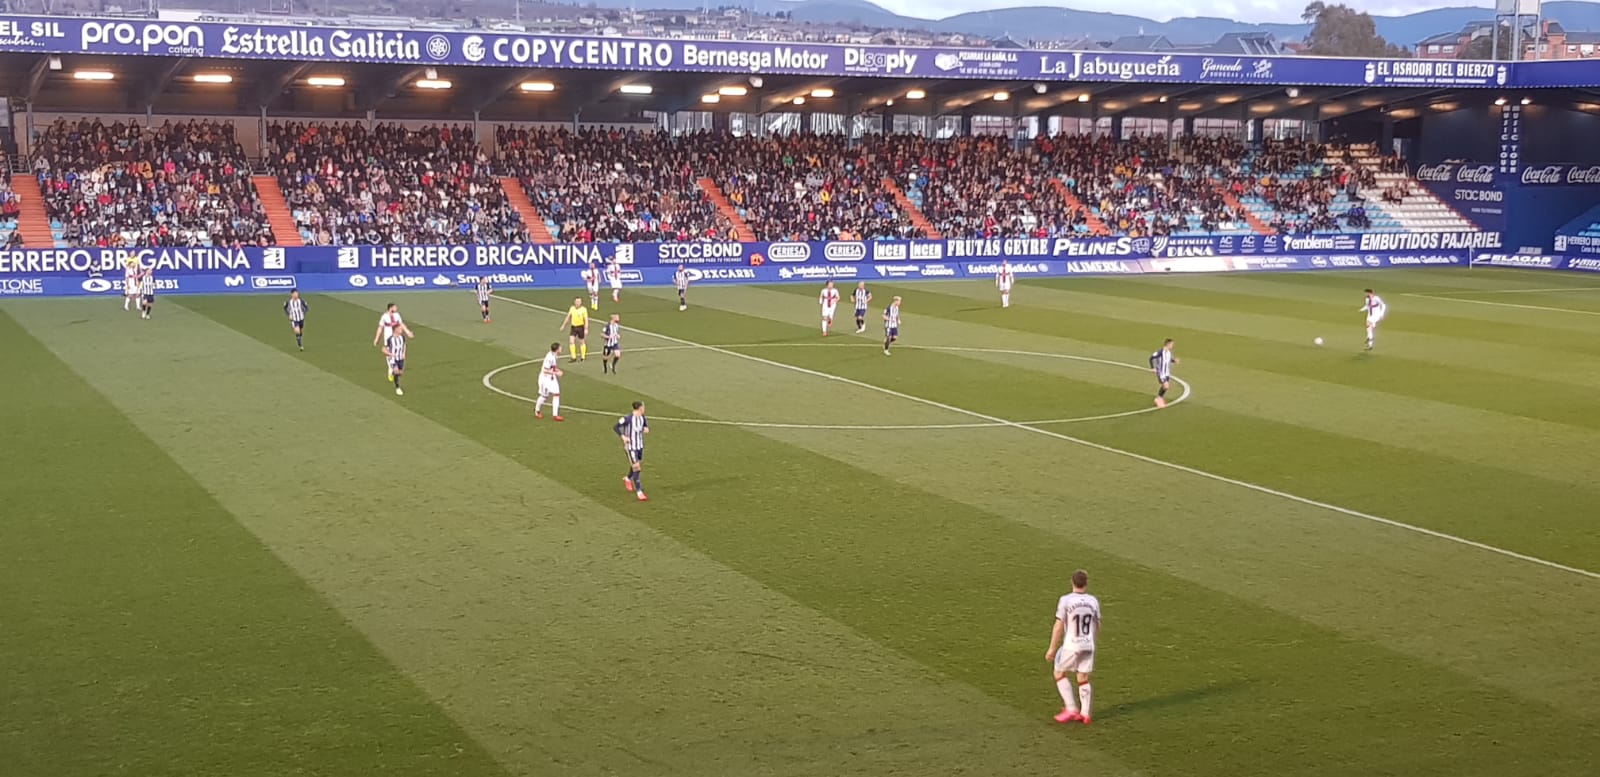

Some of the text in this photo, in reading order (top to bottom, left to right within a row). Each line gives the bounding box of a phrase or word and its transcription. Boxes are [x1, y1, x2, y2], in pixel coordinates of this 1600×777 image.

[31, 22, 64, 37] SIL
[81, 22, 204, 52] pro.pon
[168, 46, 204, 56] catering
[221, 26, 421, 60] Estrella Galicia
[493, 38, 673, 67] COPYCENTRO
[683, 44, 829, 71] Bernesga Motor
[844, 48, 917, 73] Disaply
[1040, 53, 1180, 79] La Jabugueña
[1377, 62, 1495, 77] EL ASADOR DEL BIERZO
[947, 239, 1048, 256] FRUTAS GEYRE
[1220, 236, 1233, 244] AC
[1241, 236, 1255, 244] AC
[1263, 236, 1277, 244] AC
[1291, 236, 1332, 250] emblema
[1360, 233, 1439, 250] EMBUTIDOS
[1441, 232, 1502, 249] PAJARIEL
[101, 248, 251, 271] BRGANTINA
[372, 244, 603, 267] HERRERO BRIGANTINA
[1167, 246, 1213, 257] DIANA
[375, 273, 534, 285] LaLiga SmrtBank
[703, 269, 755, 278] EXCARBI
[1072, 614, 1092, 637] 18
